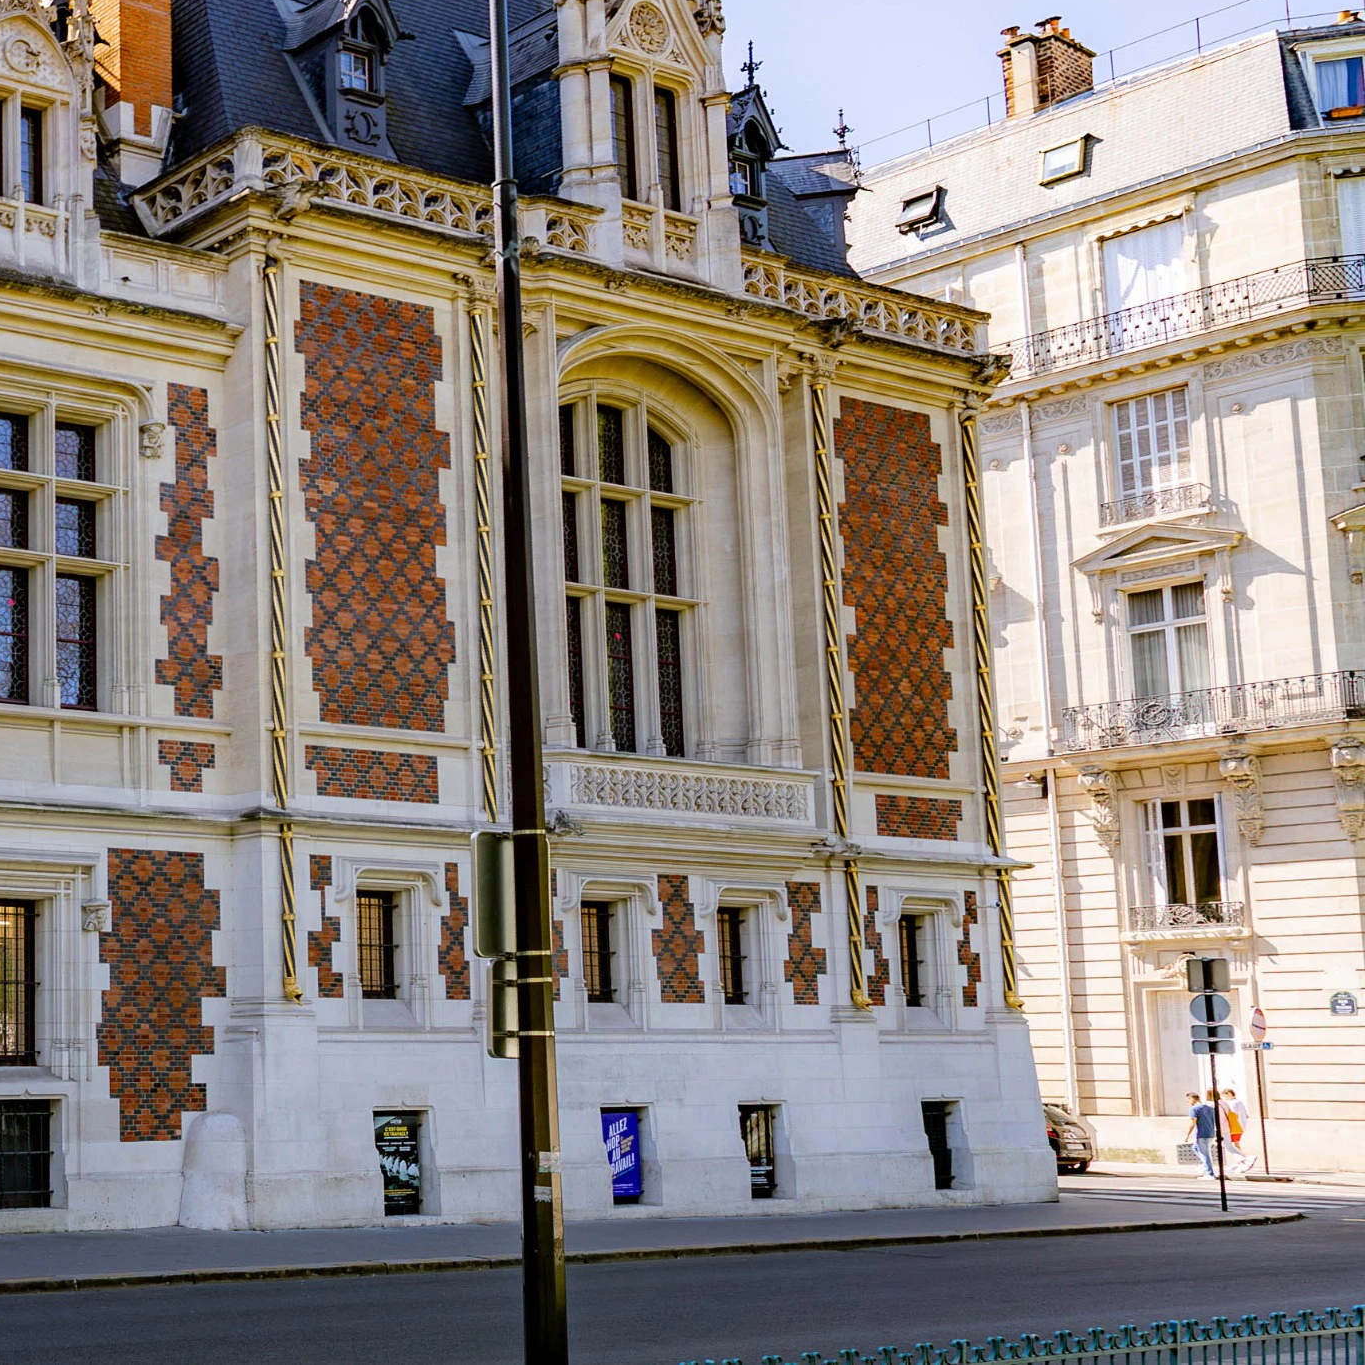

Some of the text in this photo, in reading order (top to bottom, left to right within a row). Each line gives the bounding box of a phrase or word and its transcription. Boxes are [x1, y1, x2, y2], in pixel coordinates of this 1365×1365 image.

[609, 1117, 628, 1137] ALLEZ
[606, 1135, 620, 1151] HOP
[612, 1147, 620, 1163] AU
